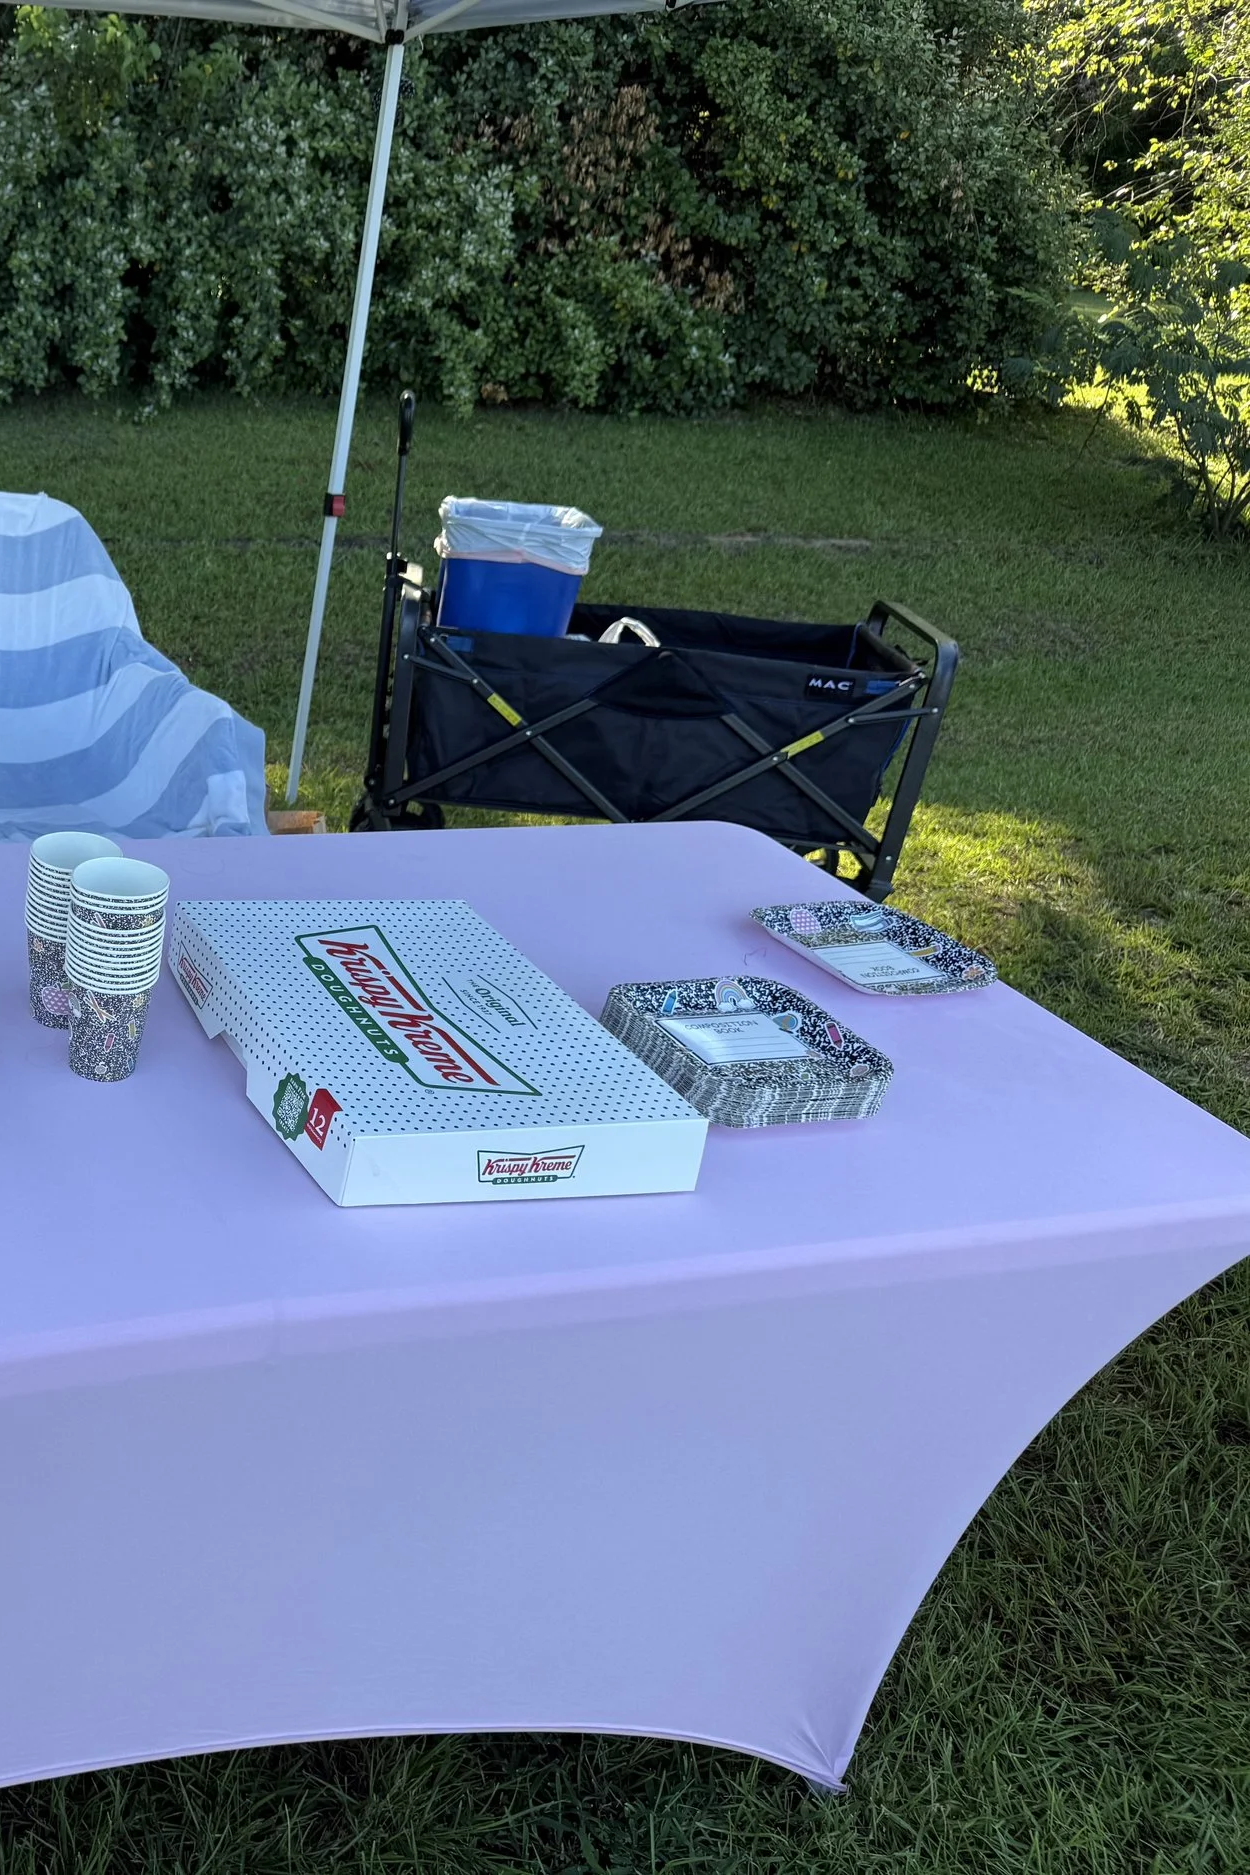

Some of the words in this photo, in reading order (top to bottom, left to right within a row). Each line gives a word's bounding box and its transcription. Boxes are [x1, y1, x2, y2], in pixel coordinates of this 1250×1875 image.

[808, 678, 850, 691] MAC
[310, 963, 399, 1056] DOUGHNUTS
[459, 988, 481, 1005] SINCE
[475, 987, 526, 1026] Original
[317, 938, 426, 1012] Krispy
[377, 1009, 501, 1086] Kreme
[309, 1107, 326, 1137] 12
[481, 1156, 532, 1177] Krispy
[527, 1154, 576, 1174] Kreme
[496, 1176, 554, 1184] DOUGHNUTS
